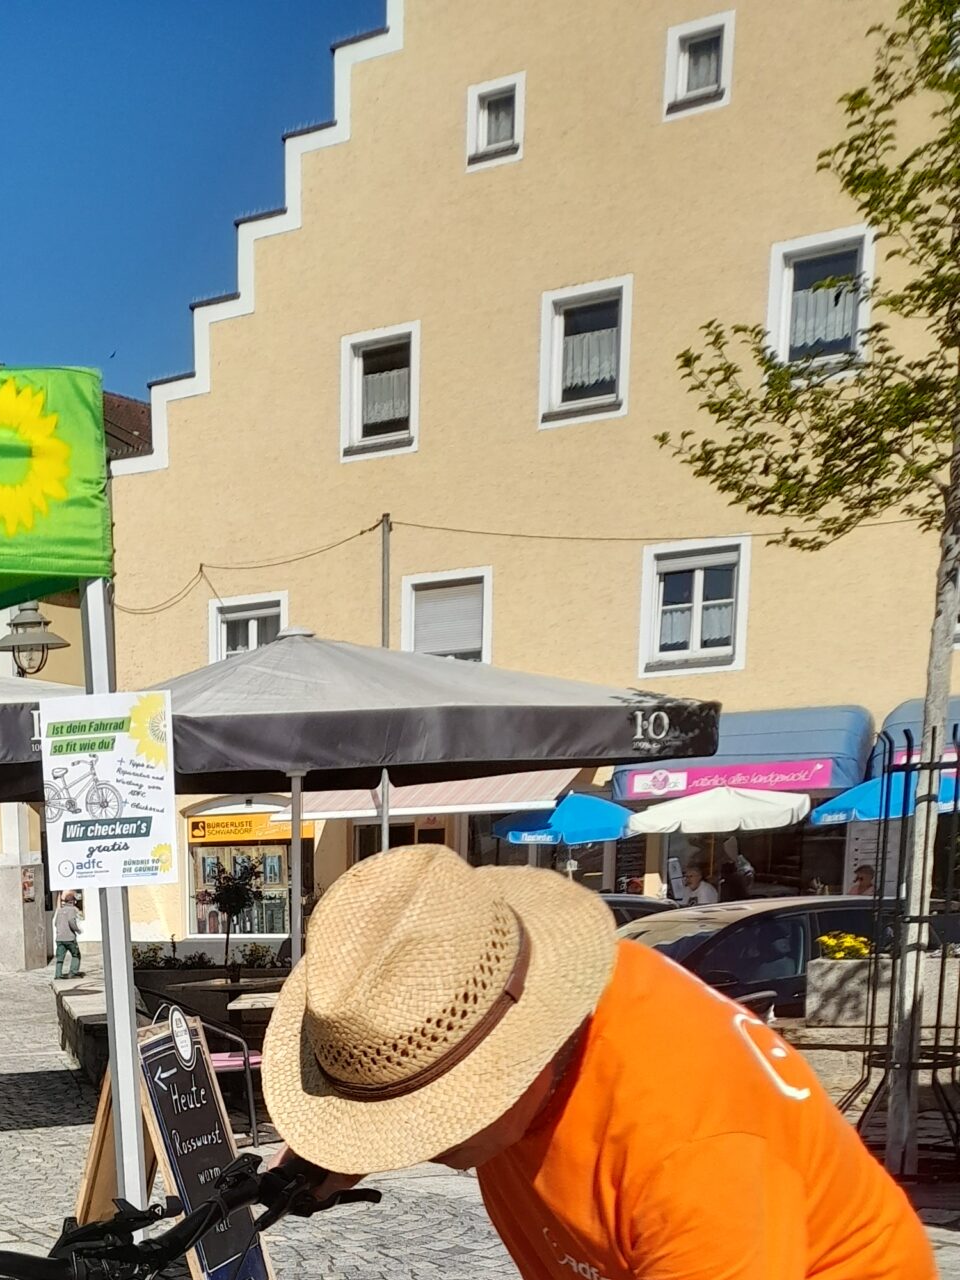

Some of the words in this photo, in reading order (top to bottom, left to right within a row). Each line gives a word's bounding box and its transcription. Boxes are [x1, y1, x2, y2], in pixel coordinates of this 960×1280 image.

[51, 723, 64, 736] Ist
[65, 720, 86, 734] dein
[88, 719, 125, 733] Fahrrad
[53, 744, 64, 753] so
[65, 741, 77, 751] fit
[79, 740, 96, 751] wie
[97, 738, 116, 750] du?
[66, 823, 86, 839] Wir
[207, 827, 253, 837] SCHWANDORF
[86, 842, 130, 858] gratis
[75, 859, 103, 870] adfc
[169, 1073, 208, 1115] Heute
[171, 1120, 223, 1157] Rosswurst
